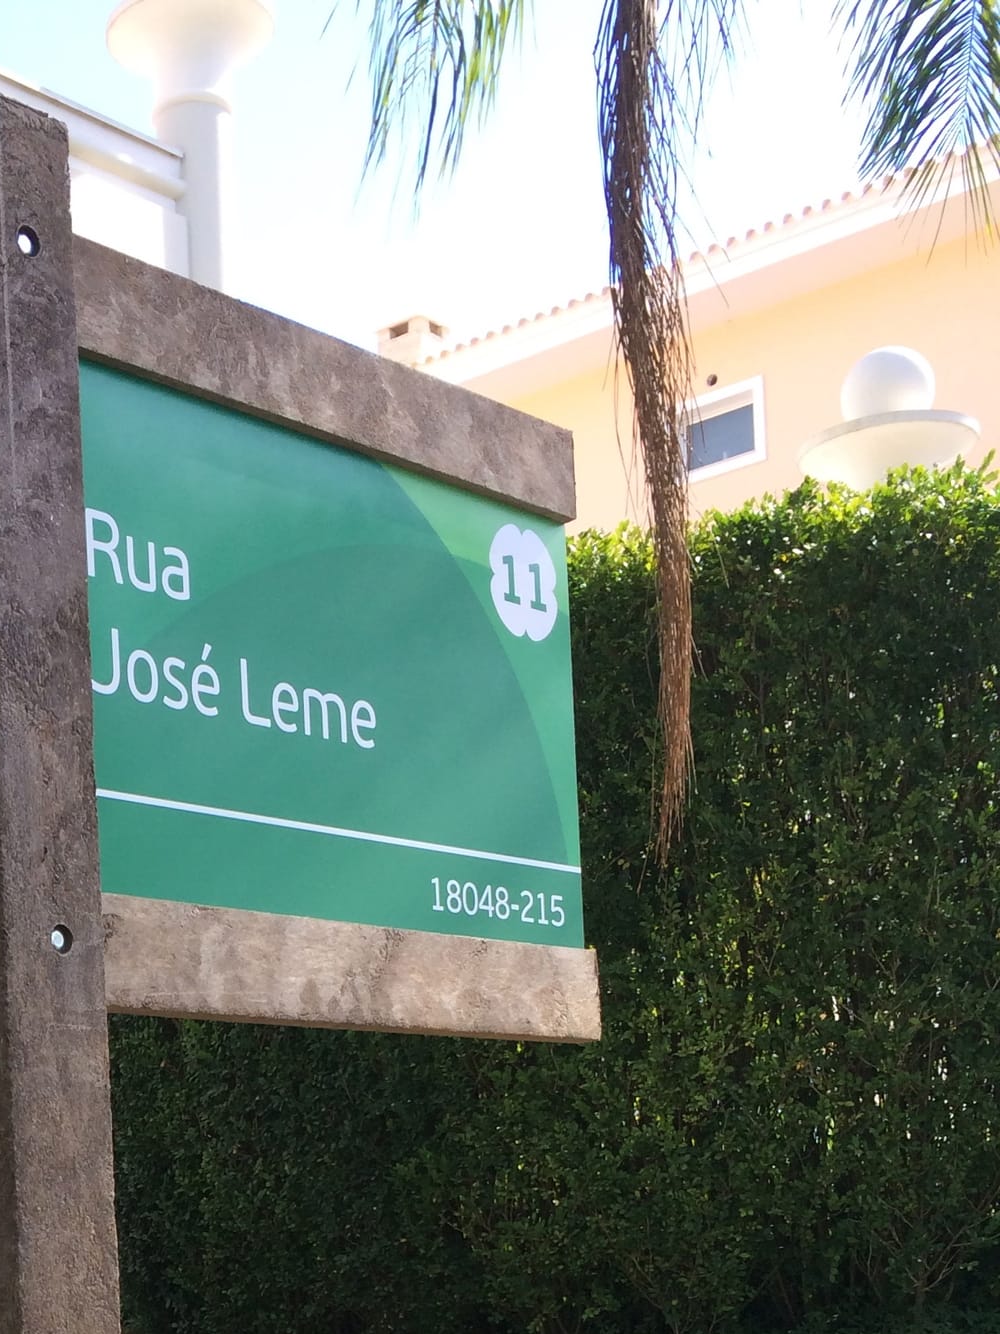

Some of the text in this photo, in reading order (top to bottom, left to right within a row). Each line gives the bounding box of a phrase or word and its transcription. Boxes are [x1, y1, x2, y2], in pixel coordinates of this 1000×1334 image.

[84, 507, 191, 601] Rua
[501, 554, 548, 613] 11
[90, 627, 378, 750] José Leme
[430, 876, 566, 929] 18048-215
